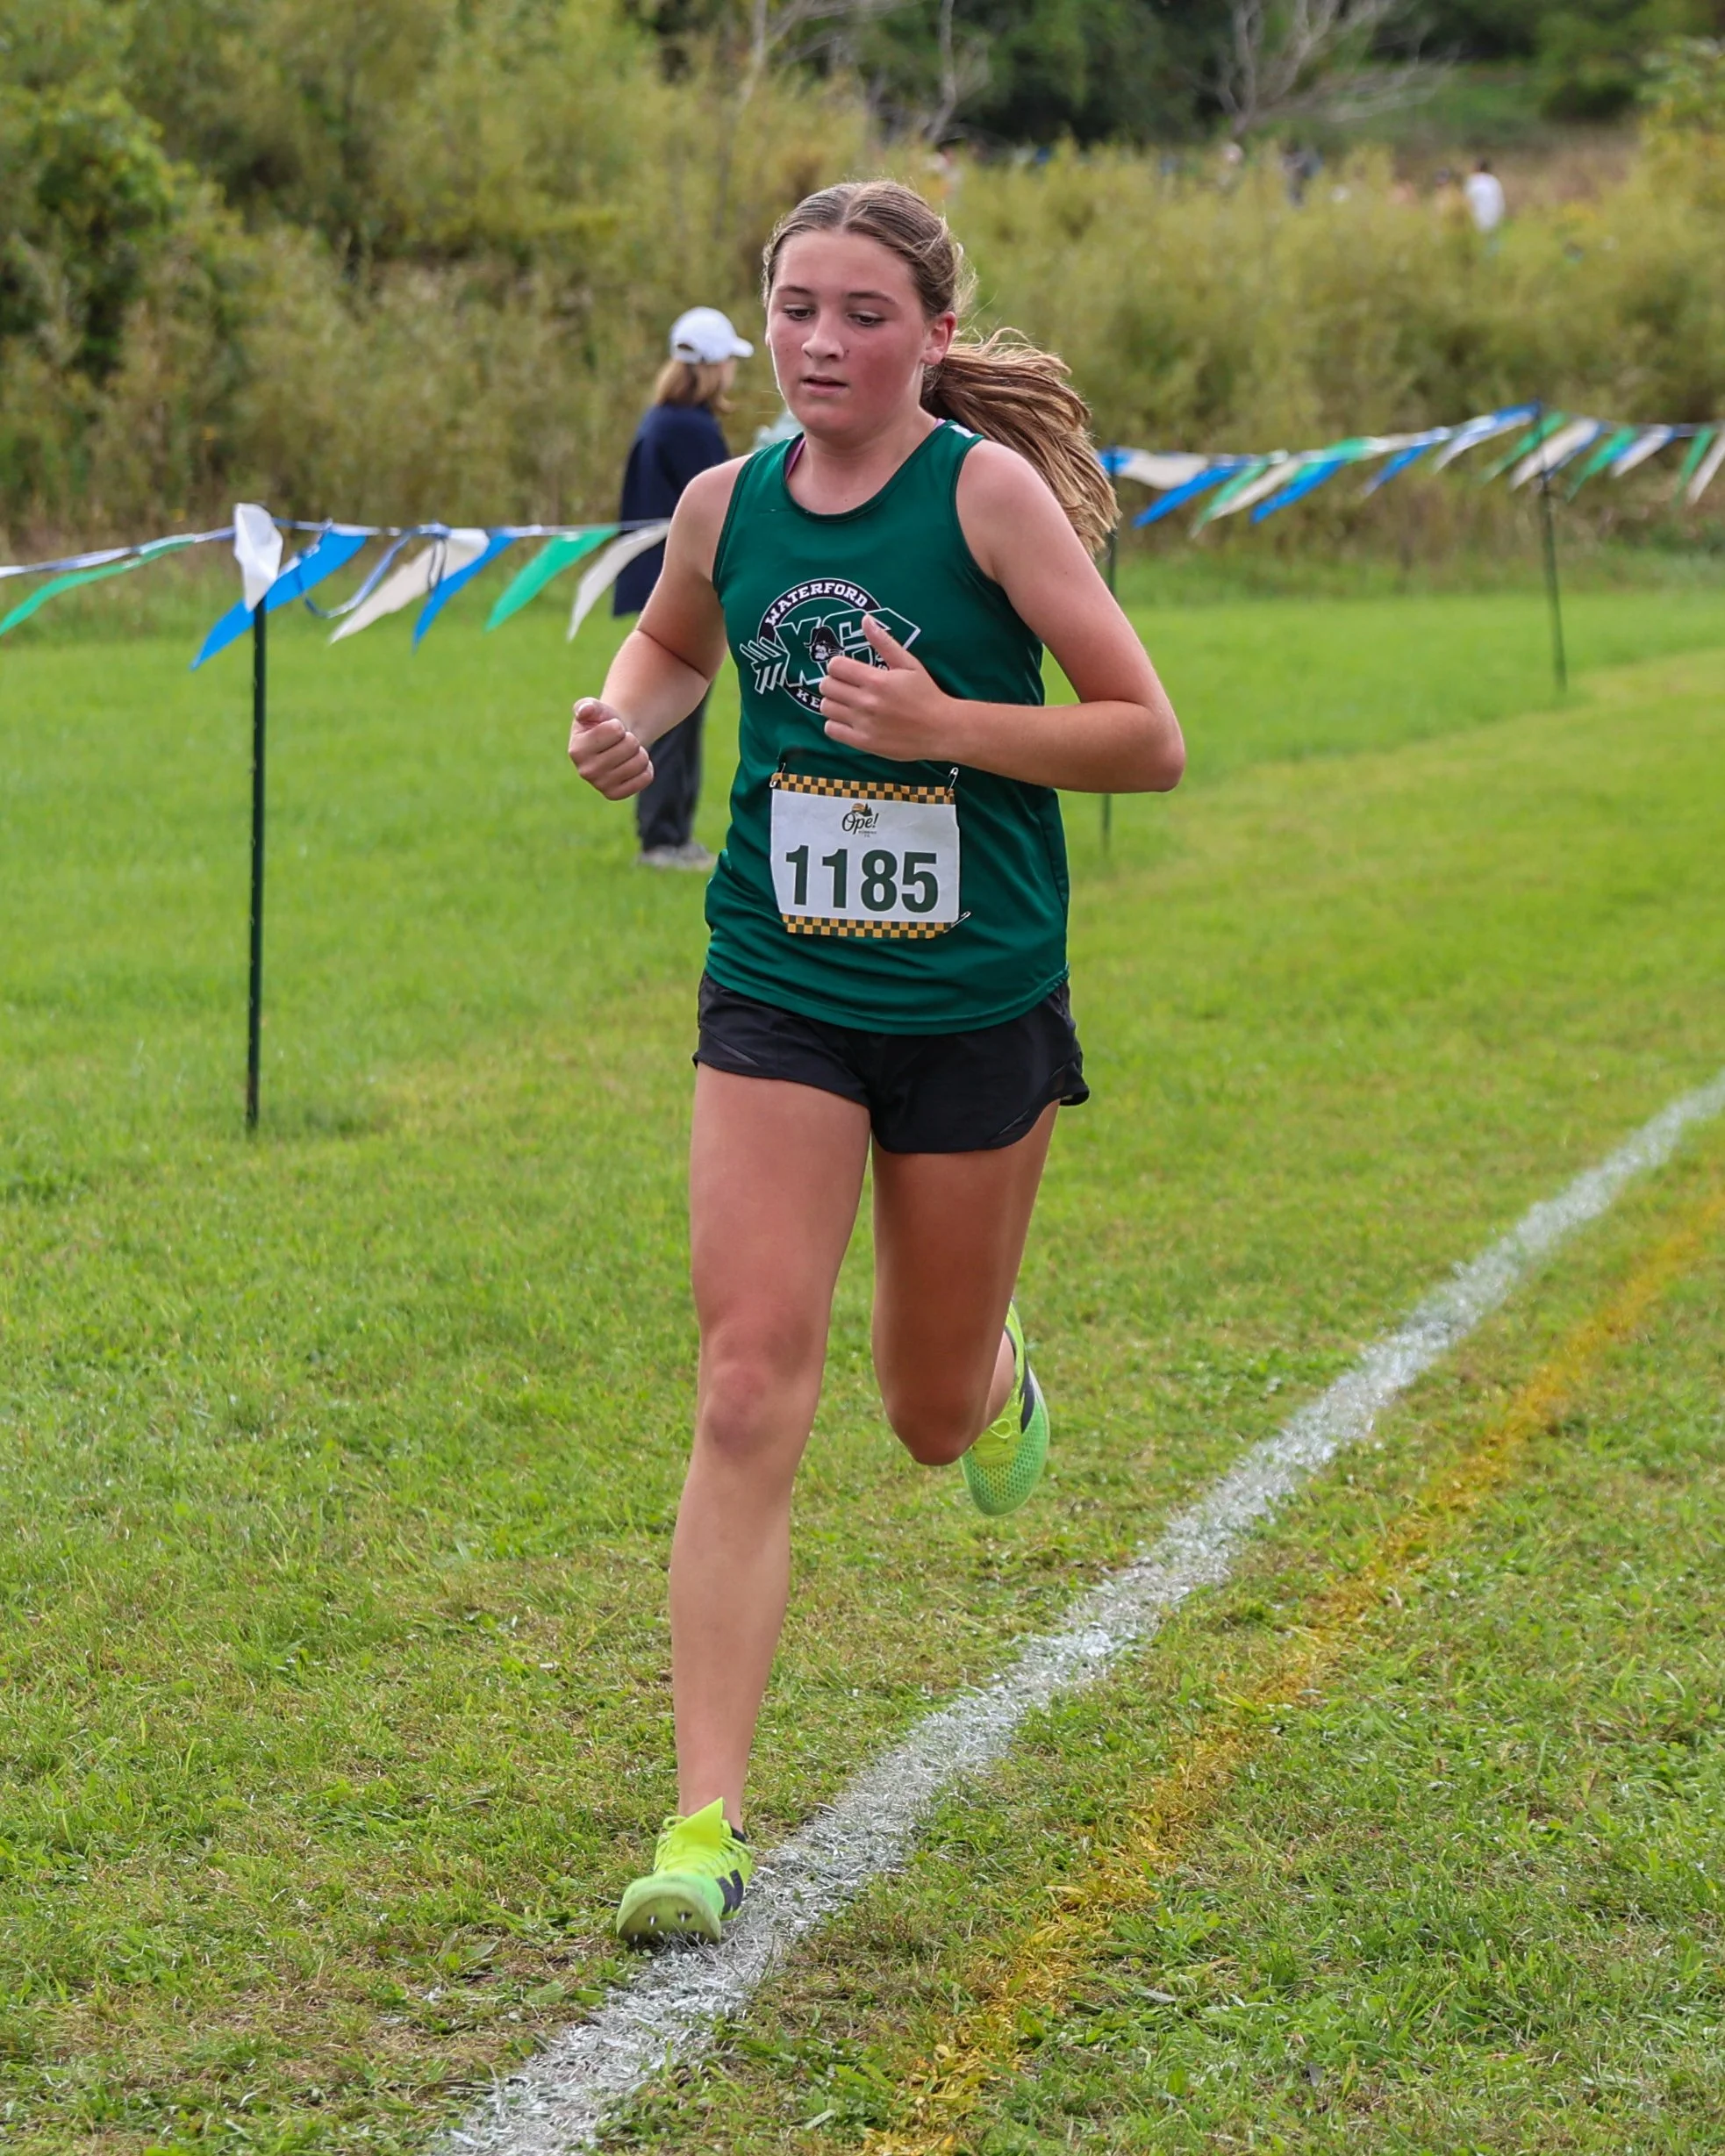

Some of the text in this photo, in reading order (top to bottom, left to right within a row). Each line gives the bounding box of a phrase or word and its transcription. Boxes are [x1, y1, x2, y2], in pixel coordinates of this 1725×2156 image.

[765, 583, 868, 626] WATERFORD
[841, 813, 878, 834] Ope!
[785, 844, 939, 913] 1185
